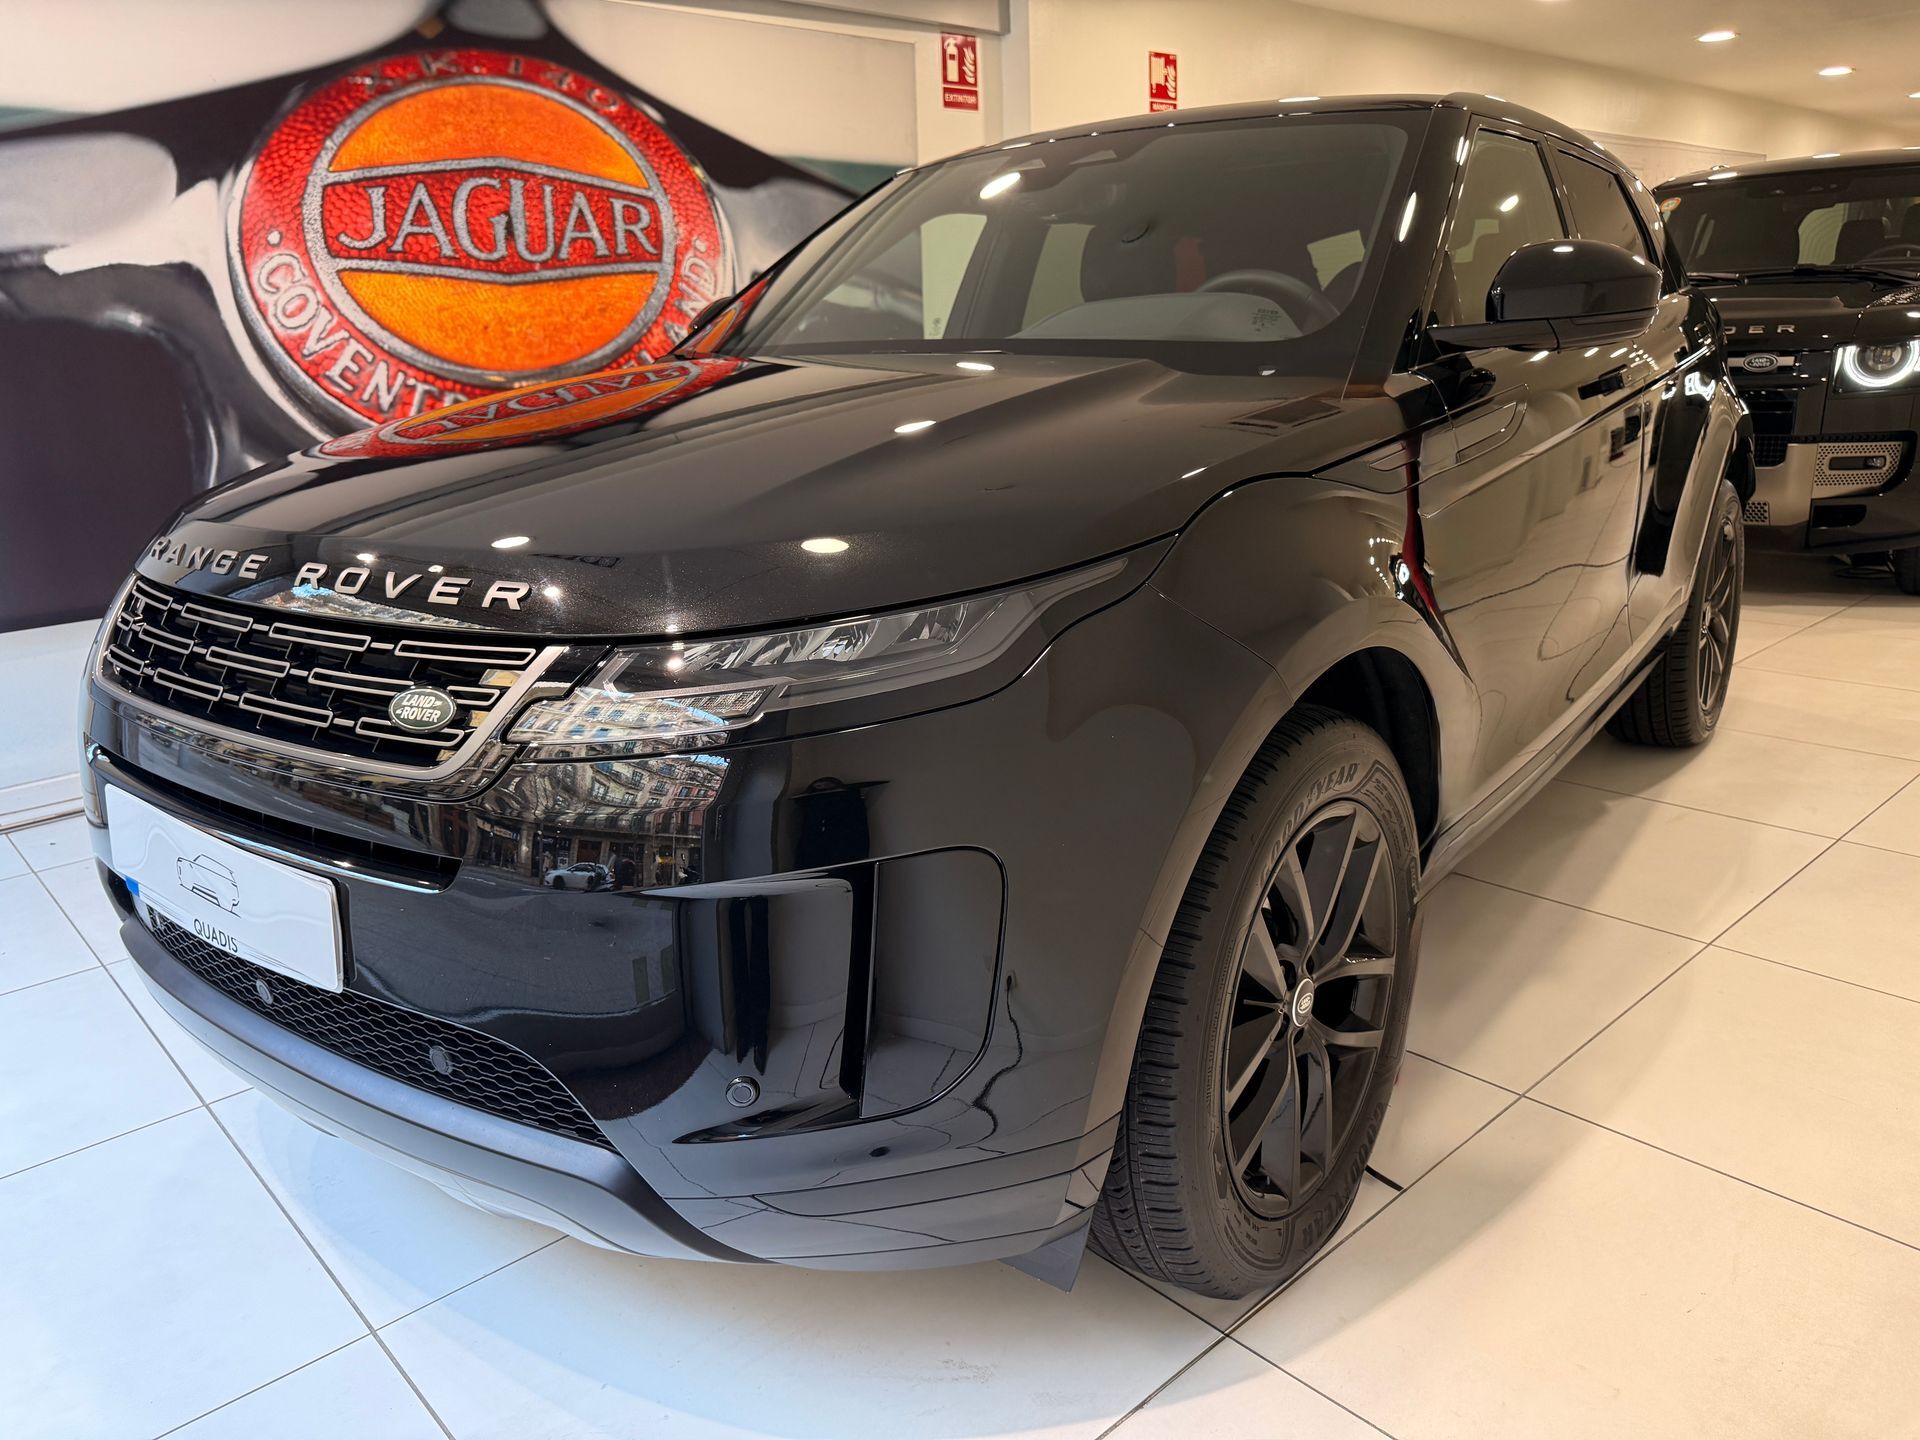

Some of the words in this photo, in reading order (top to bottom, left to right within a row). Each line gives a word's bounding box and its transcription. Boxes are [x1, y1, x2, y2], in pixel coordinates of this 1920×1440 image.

[336, 176, 660, 264] JAGUAR
[258, 252, 469, 417] COVENT
[1722, 324, 1795, 335] DER
[149, 536, 272, 580] RANGE
[294, 561, 532, 611] ROVER
[400, 706, 442, 723] ROVER
[402, 693, 436, 708] LAND
[193, 918, 239, 953] QUADIS
